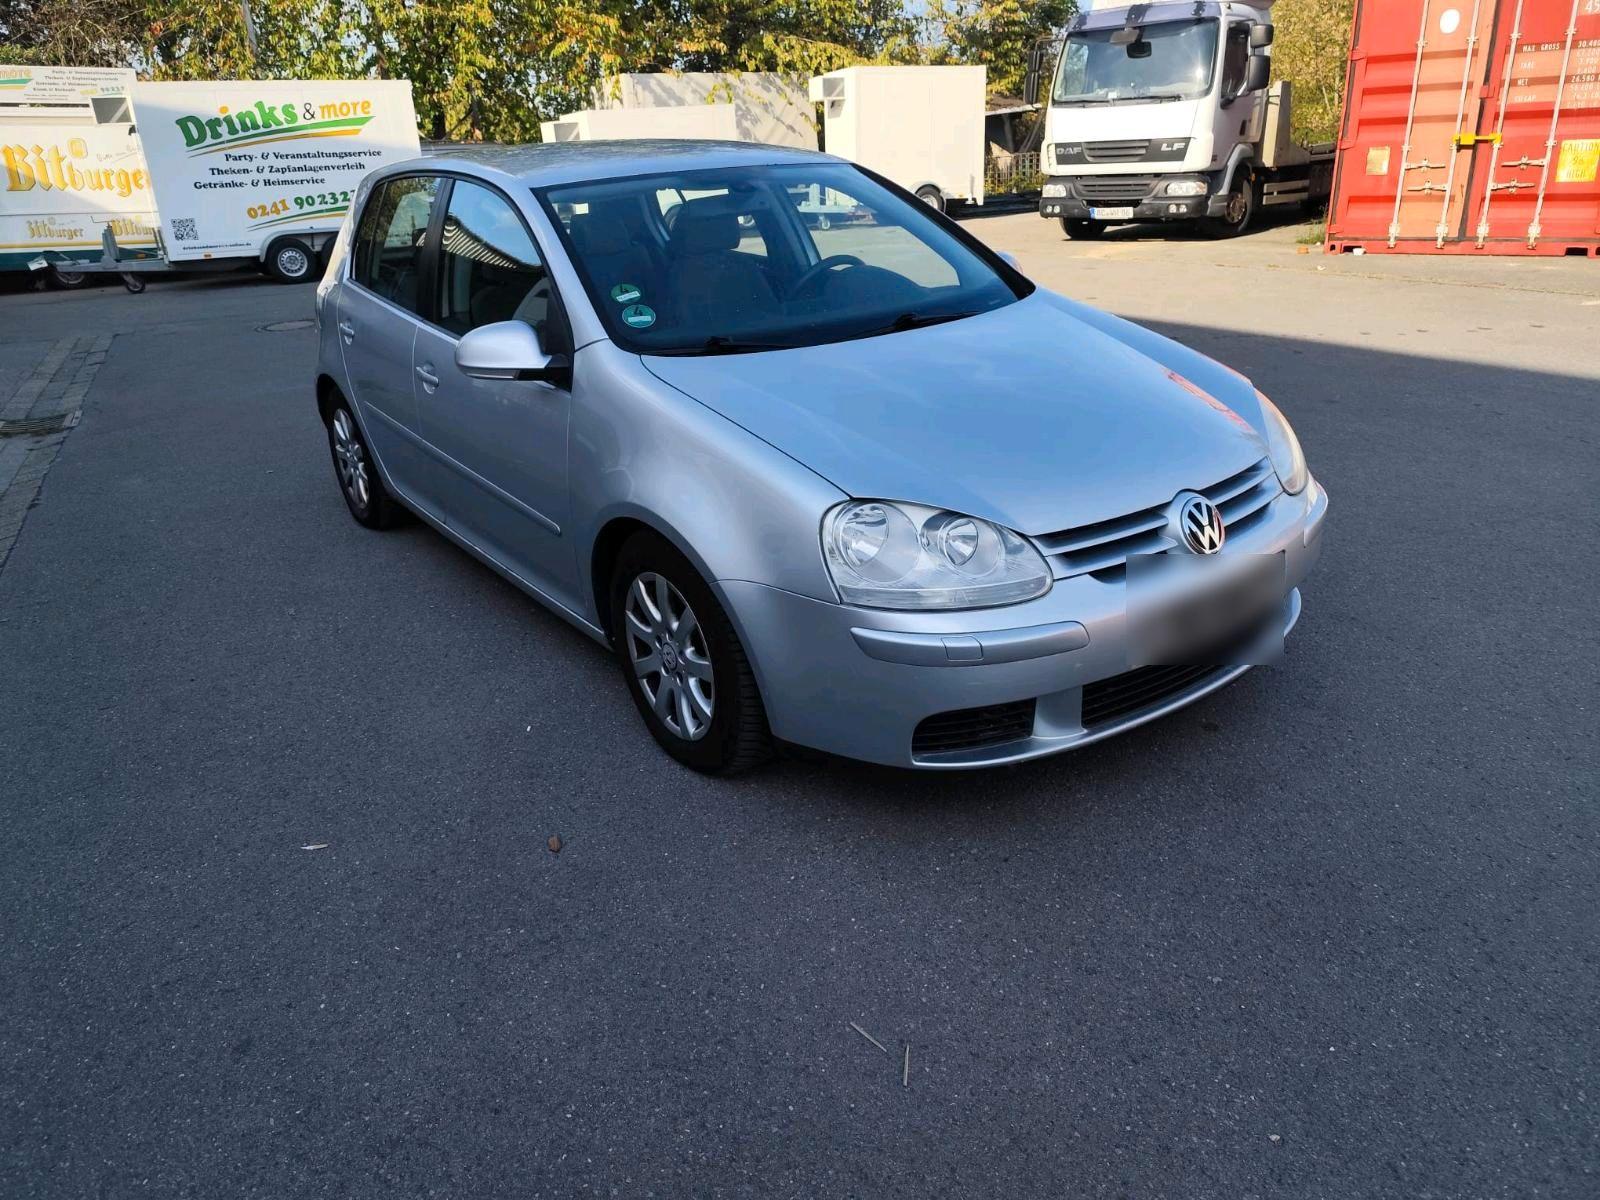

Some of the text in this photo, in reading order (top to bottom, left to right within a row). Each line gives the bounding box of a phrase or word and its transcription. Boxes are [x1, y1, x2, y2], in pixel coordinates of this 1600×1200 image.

[1540, 42, 1560, 51] GROSS
[1517, 78, 1529, 86] NET
[175, 99, 373, 148] Drinks & more
[224, 148, 383, 164] Party- & Veranstaltungsservice
[1056, 142, 1186, 156] DAF LF
[208, 162, 366, 177] Theken- & Zapfanlagenverleih
[193, 176, 326, 191] Getränke- & Heimservice
[246, 198, 290, 220] 0241
